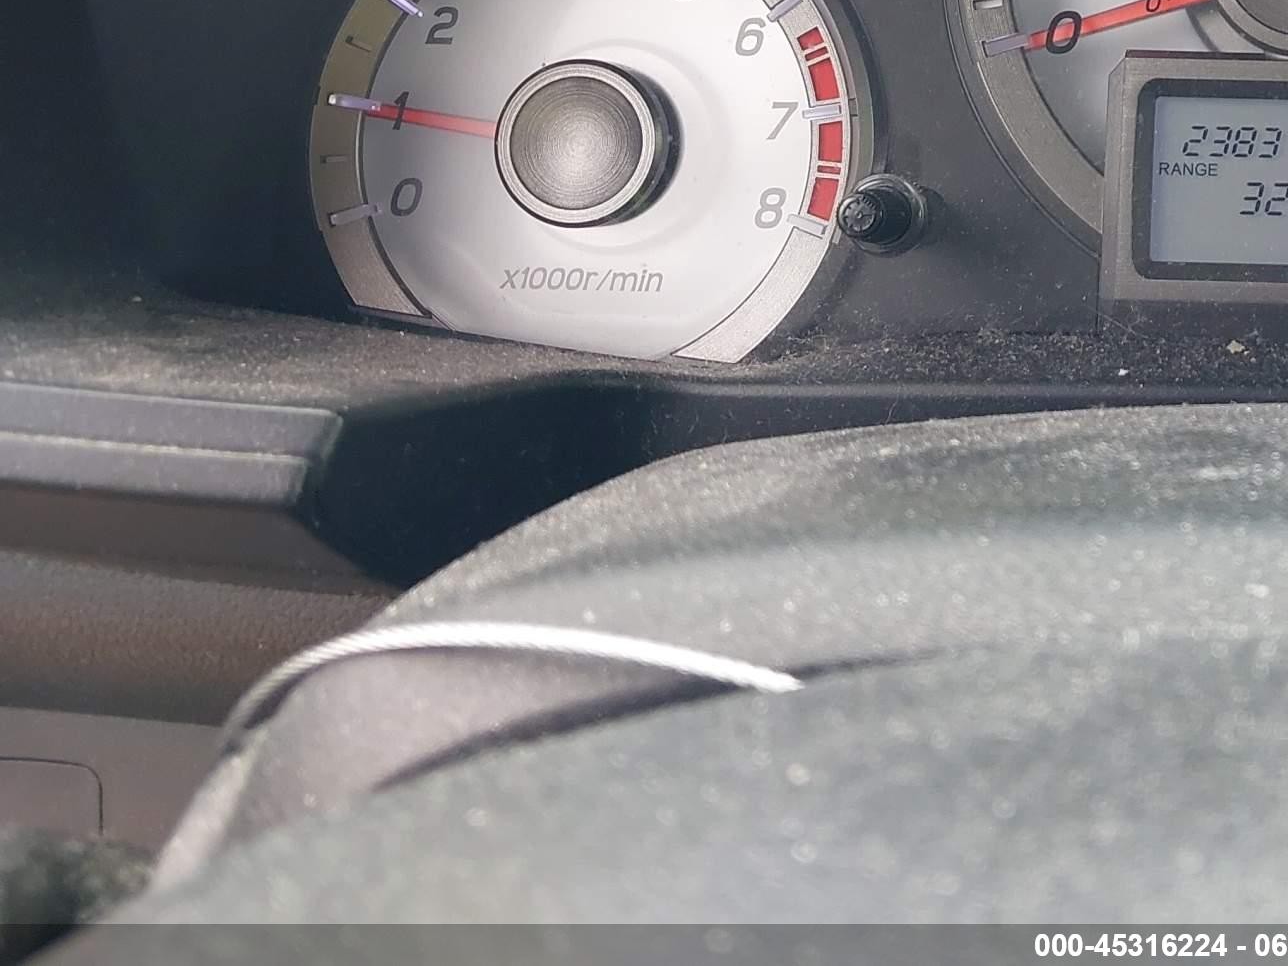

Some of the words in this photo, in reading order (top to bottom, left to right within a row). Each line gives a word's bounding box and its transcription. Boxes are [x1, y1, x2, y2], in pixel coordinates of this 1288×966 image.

[426, 6, 459, 44] 2
[735, 18, 764, 56] 6
[1045, 10, 1082, 54] 0
[392, 91, 410, 131] 1
[768, 101, 798, 140] 7
[1158, 162, 1218, 177] RANGE
[391, 177, 423, 216] 0
[755, 188, 786, 229] 8
[500, 266, 664, 293] x1000r/min
